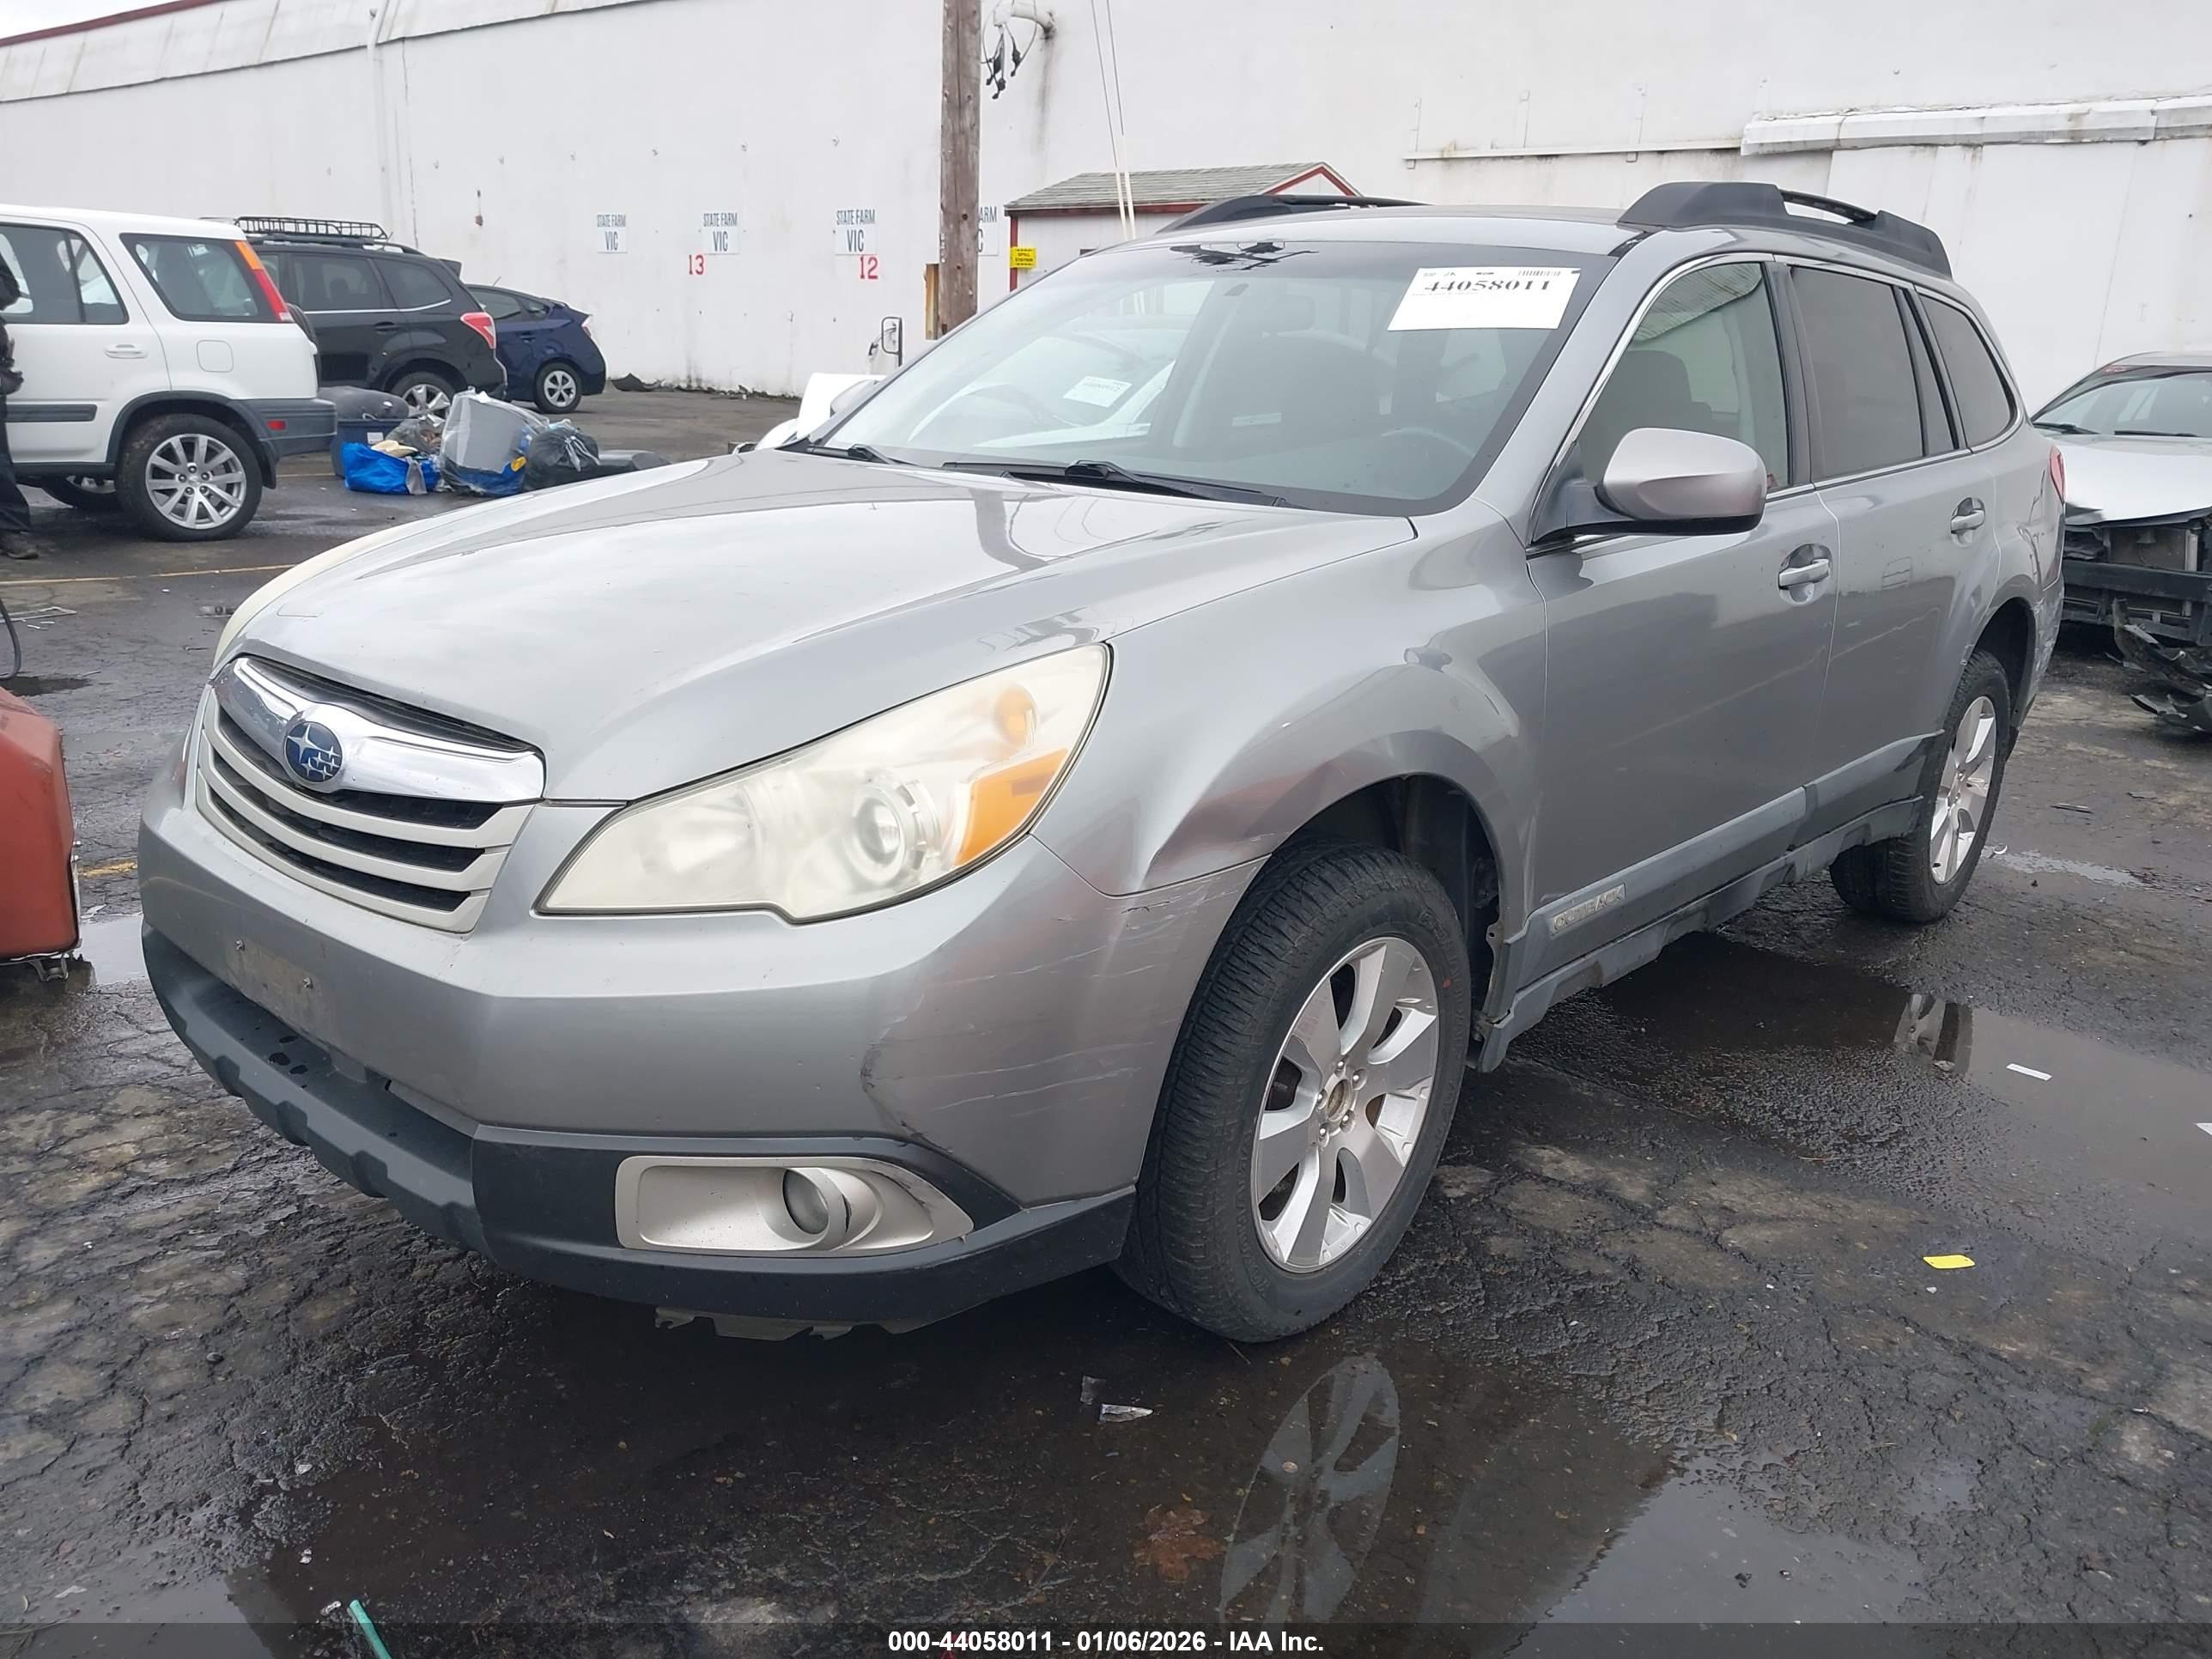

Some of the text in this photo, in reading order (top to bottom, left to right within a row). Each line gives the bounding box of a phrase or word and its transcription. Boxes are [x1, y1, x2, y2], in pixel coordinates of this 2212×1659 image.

[597, 214, 627, 227] STATE FARM
[702, 212, 738, 227] STATE FARM
[836, 208, 875, 225] STATE FARM
[978, 205, 997, 223] ARM
[605, 230, 618, 251] VIC
[713, 230, 728, 252] VIC
[847, 228, 864, 252] VIC
[688, 254, 704, 275] 13
[860, 255, 878, 279] 12
[1425, 280, 1551, 292] 44058011
